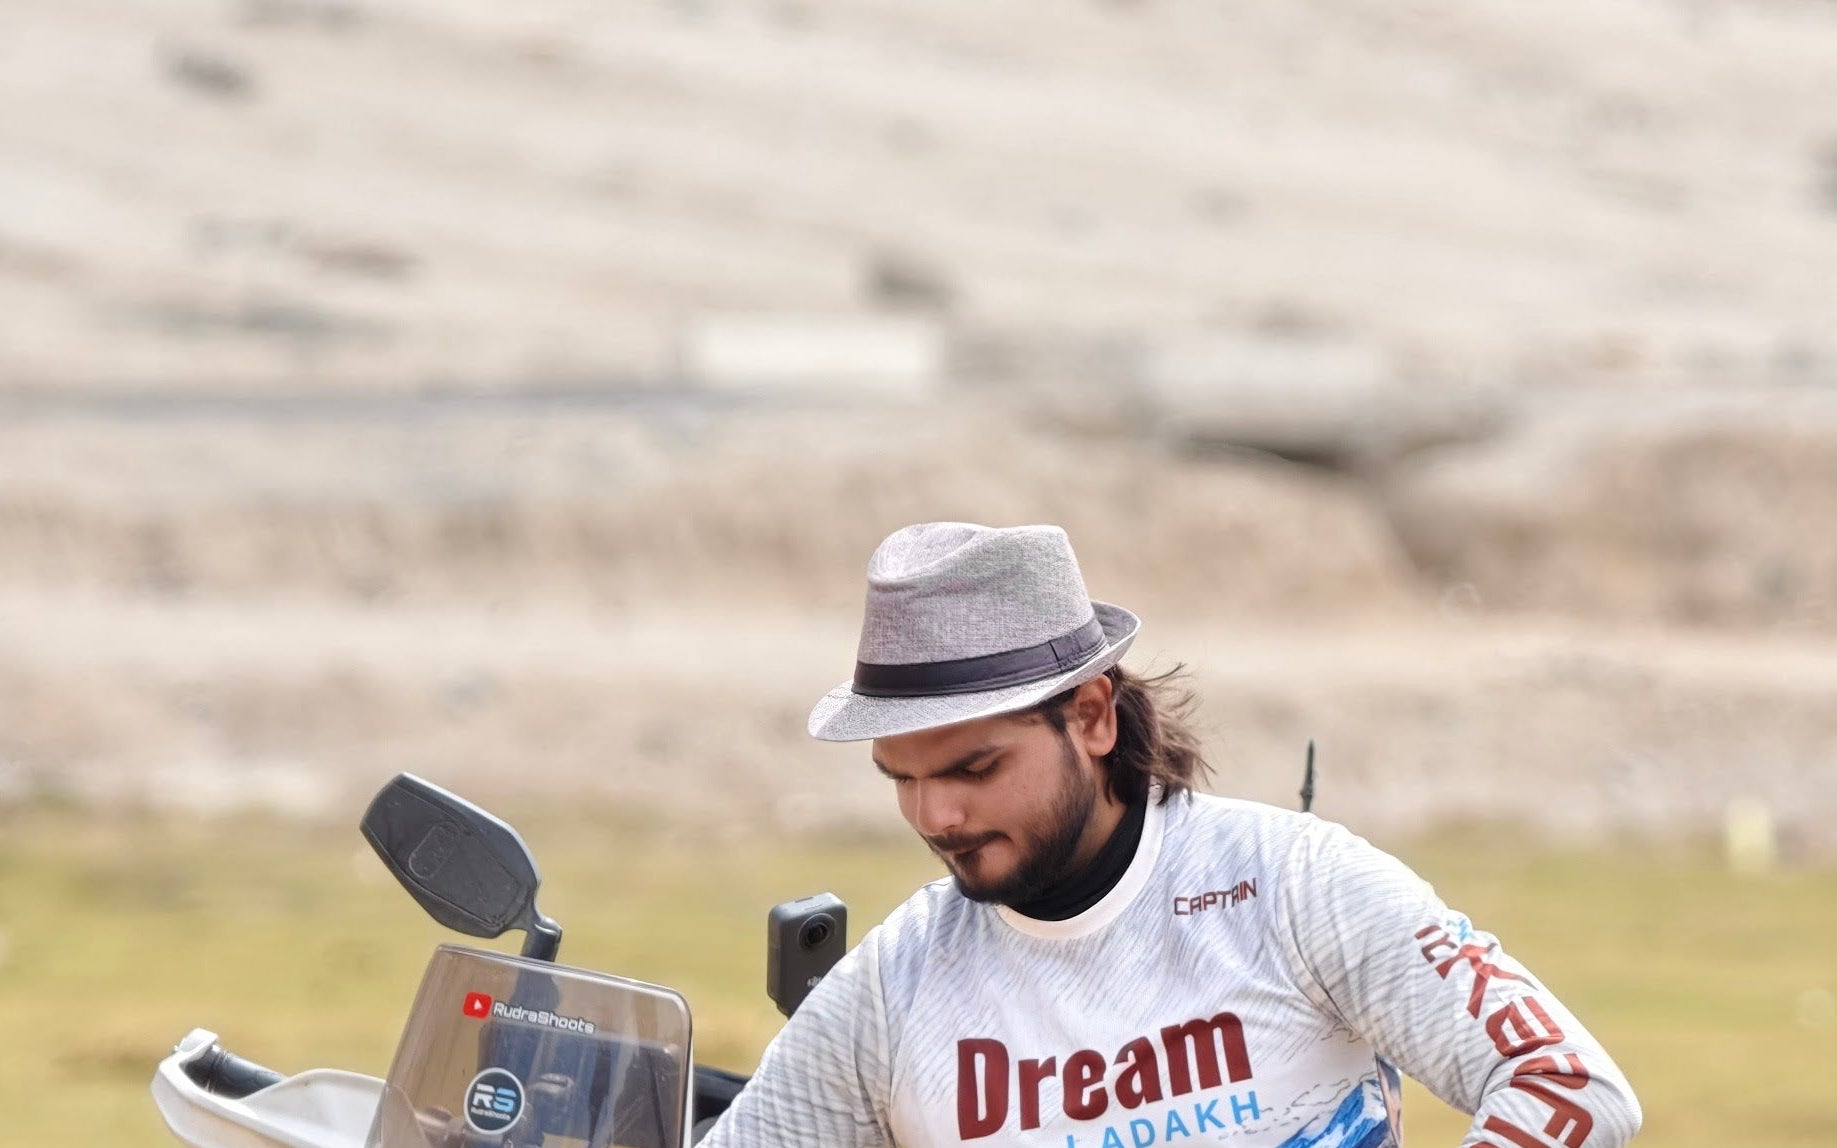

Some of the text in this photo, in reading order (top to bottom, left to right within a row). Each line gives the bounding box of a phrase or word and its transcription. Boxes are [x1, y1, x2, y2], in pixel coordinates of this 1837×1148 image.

[1173, 877, 1258, 917] CAPTAIN
[493, 1001, 595, 1035] RudraShoots
[956, 1011, 1254, 1141] Dream
[472, 1083, 517, 1113] RS
